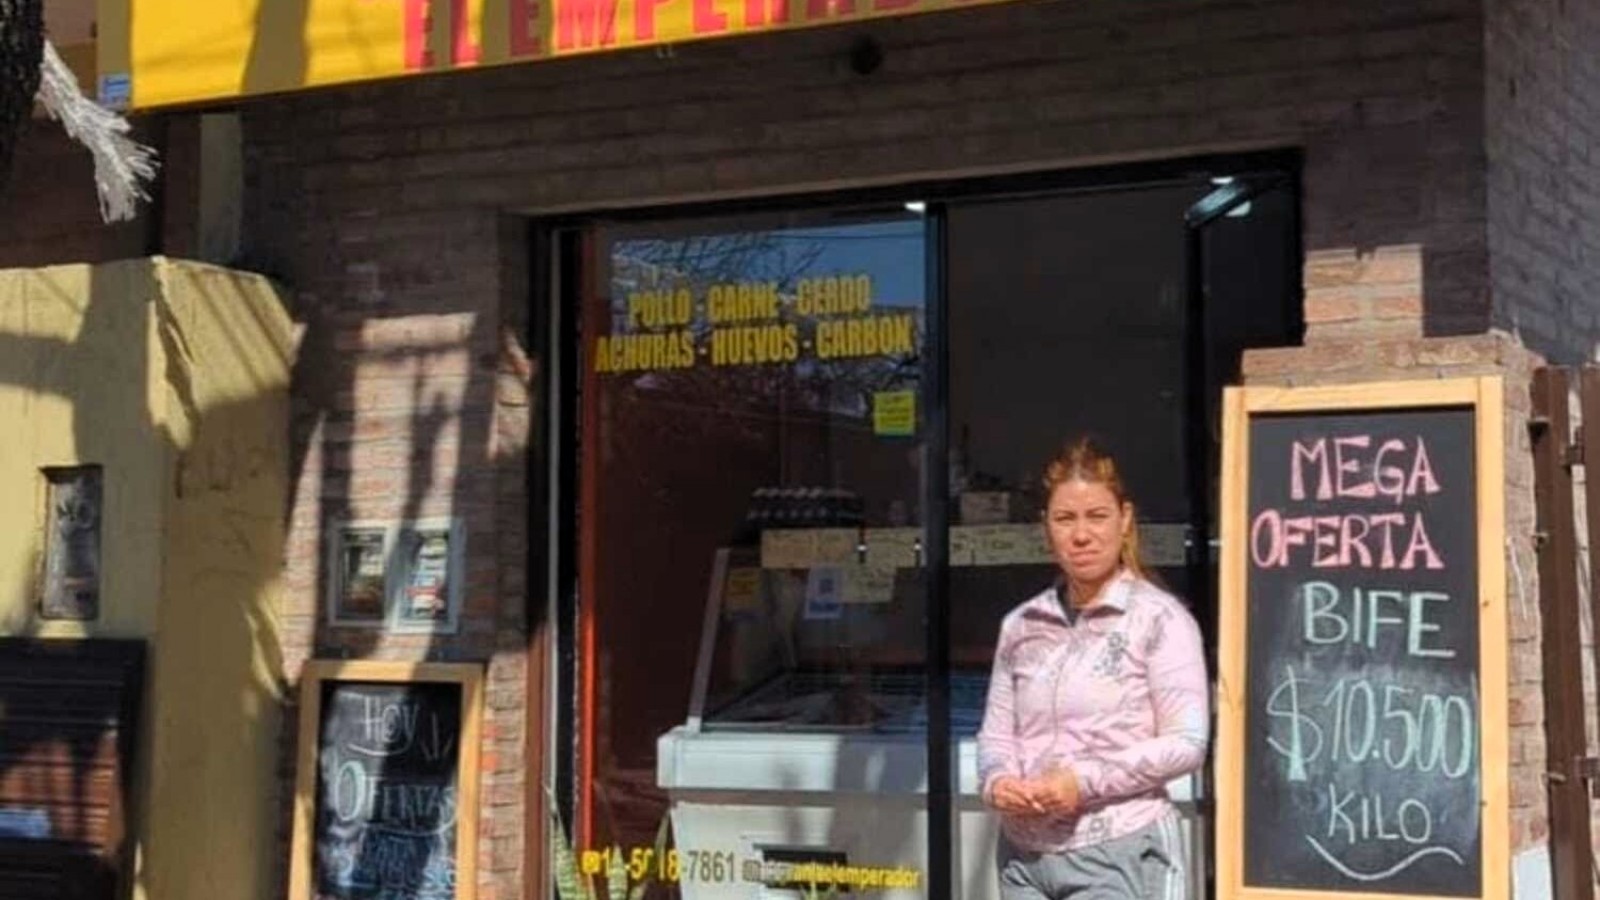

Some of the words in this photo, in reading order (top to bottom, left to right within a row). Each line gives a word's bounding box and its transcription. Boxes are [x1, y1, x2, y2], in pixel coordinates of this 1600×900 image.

[630, 290, 691, 326] POLLO
[708, 284, 779, 321] CARNE
[797, 275, 871, 314] CERDO
[595, 331, 696, 372] ACHURAS
[711, 323, 798, 366] HUEVOS
[1290, 435, 1440, 502] MEGA
[1251, 509, 1444, 569] OFERTA
[1303, 581, 1456, 657] BIFE
[1266, 665, 1472, 781] $10.500
[1328, 783, 1431, 844] KILO
